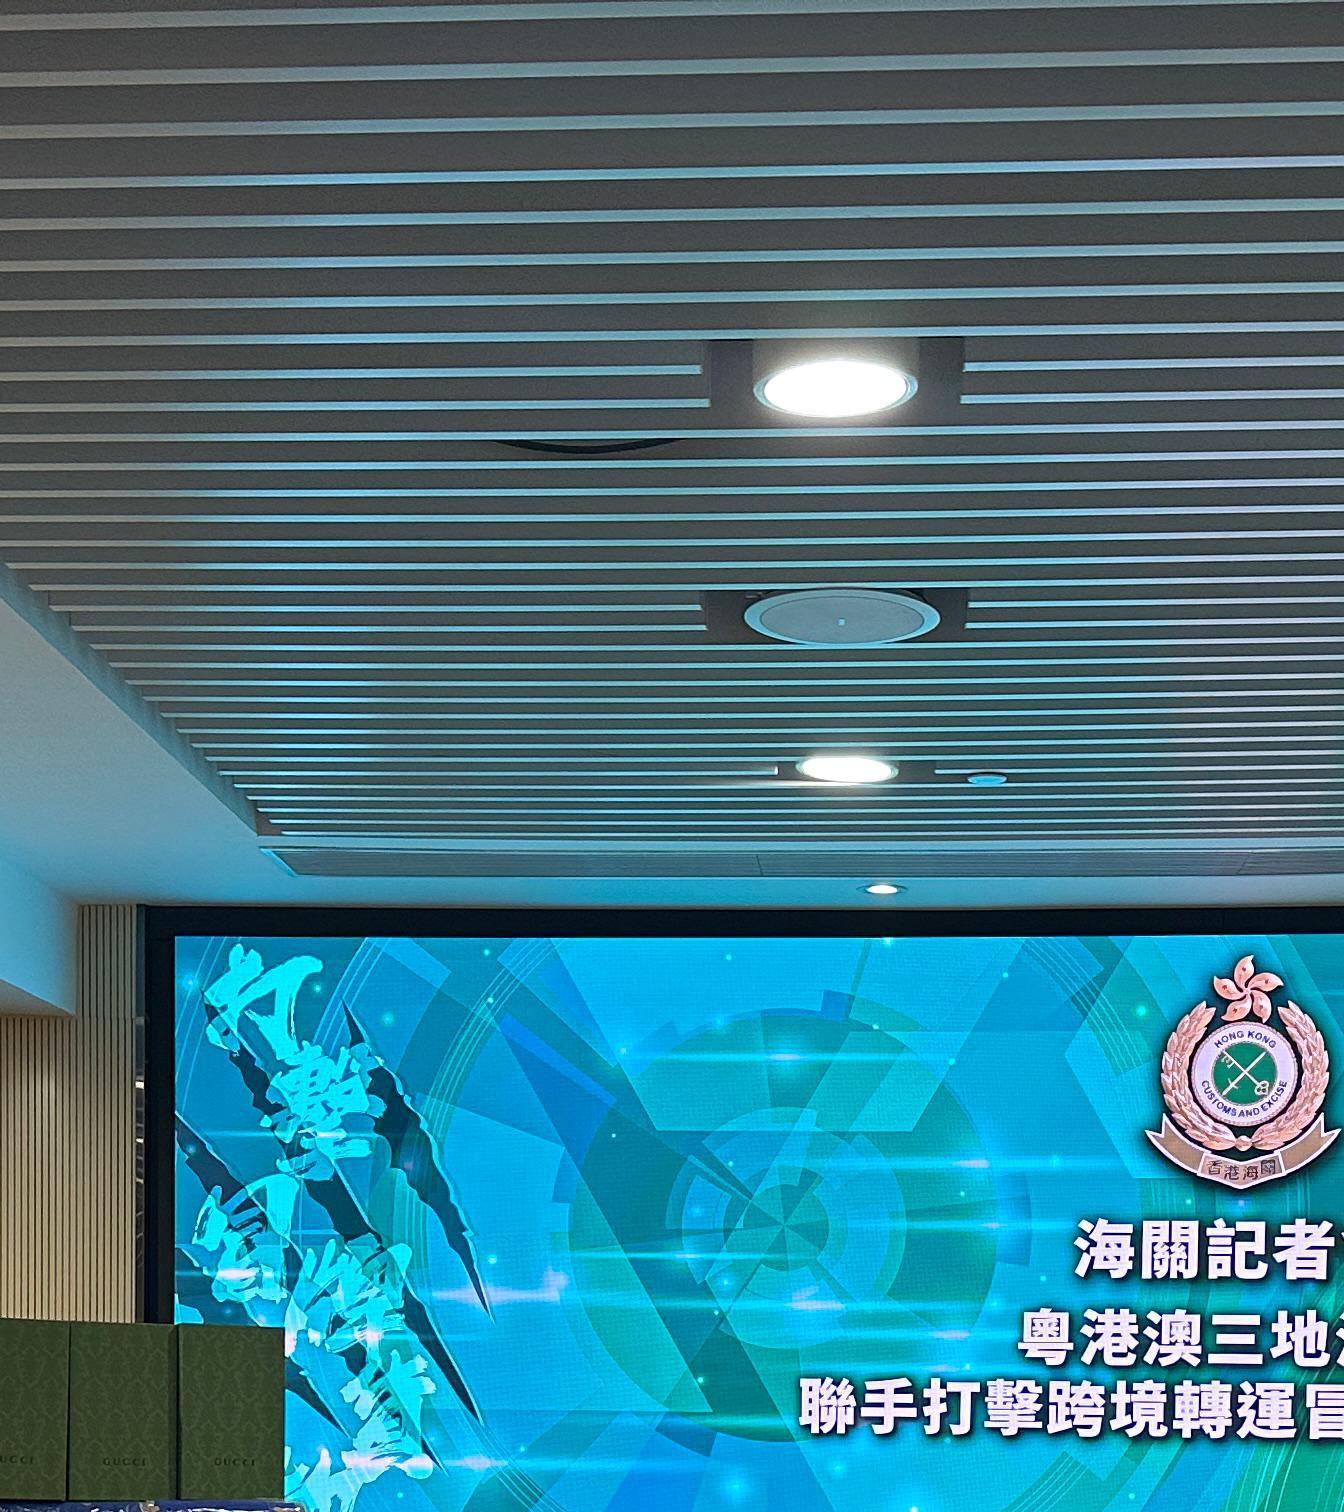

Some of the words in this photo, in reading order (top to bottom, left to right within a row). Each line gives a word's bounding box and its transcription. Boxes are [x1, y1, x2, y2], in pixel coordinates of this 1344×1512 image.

[1213, 1030, 1246, 1049] HONG
[1247, 1030, 1277, 1049] KONG
[1201, 1080, 1237, 1117] CUSTOMS
[1238, 1107, 1260, 1118] AND
[1260, 1079, 1288, 1112] EXCISE
[1207, 1159, 1276, 1181] 香港海關
[102, 1457, 147, 1466] GUCCI
[213, 1458, 257, 1467] GUCCI
